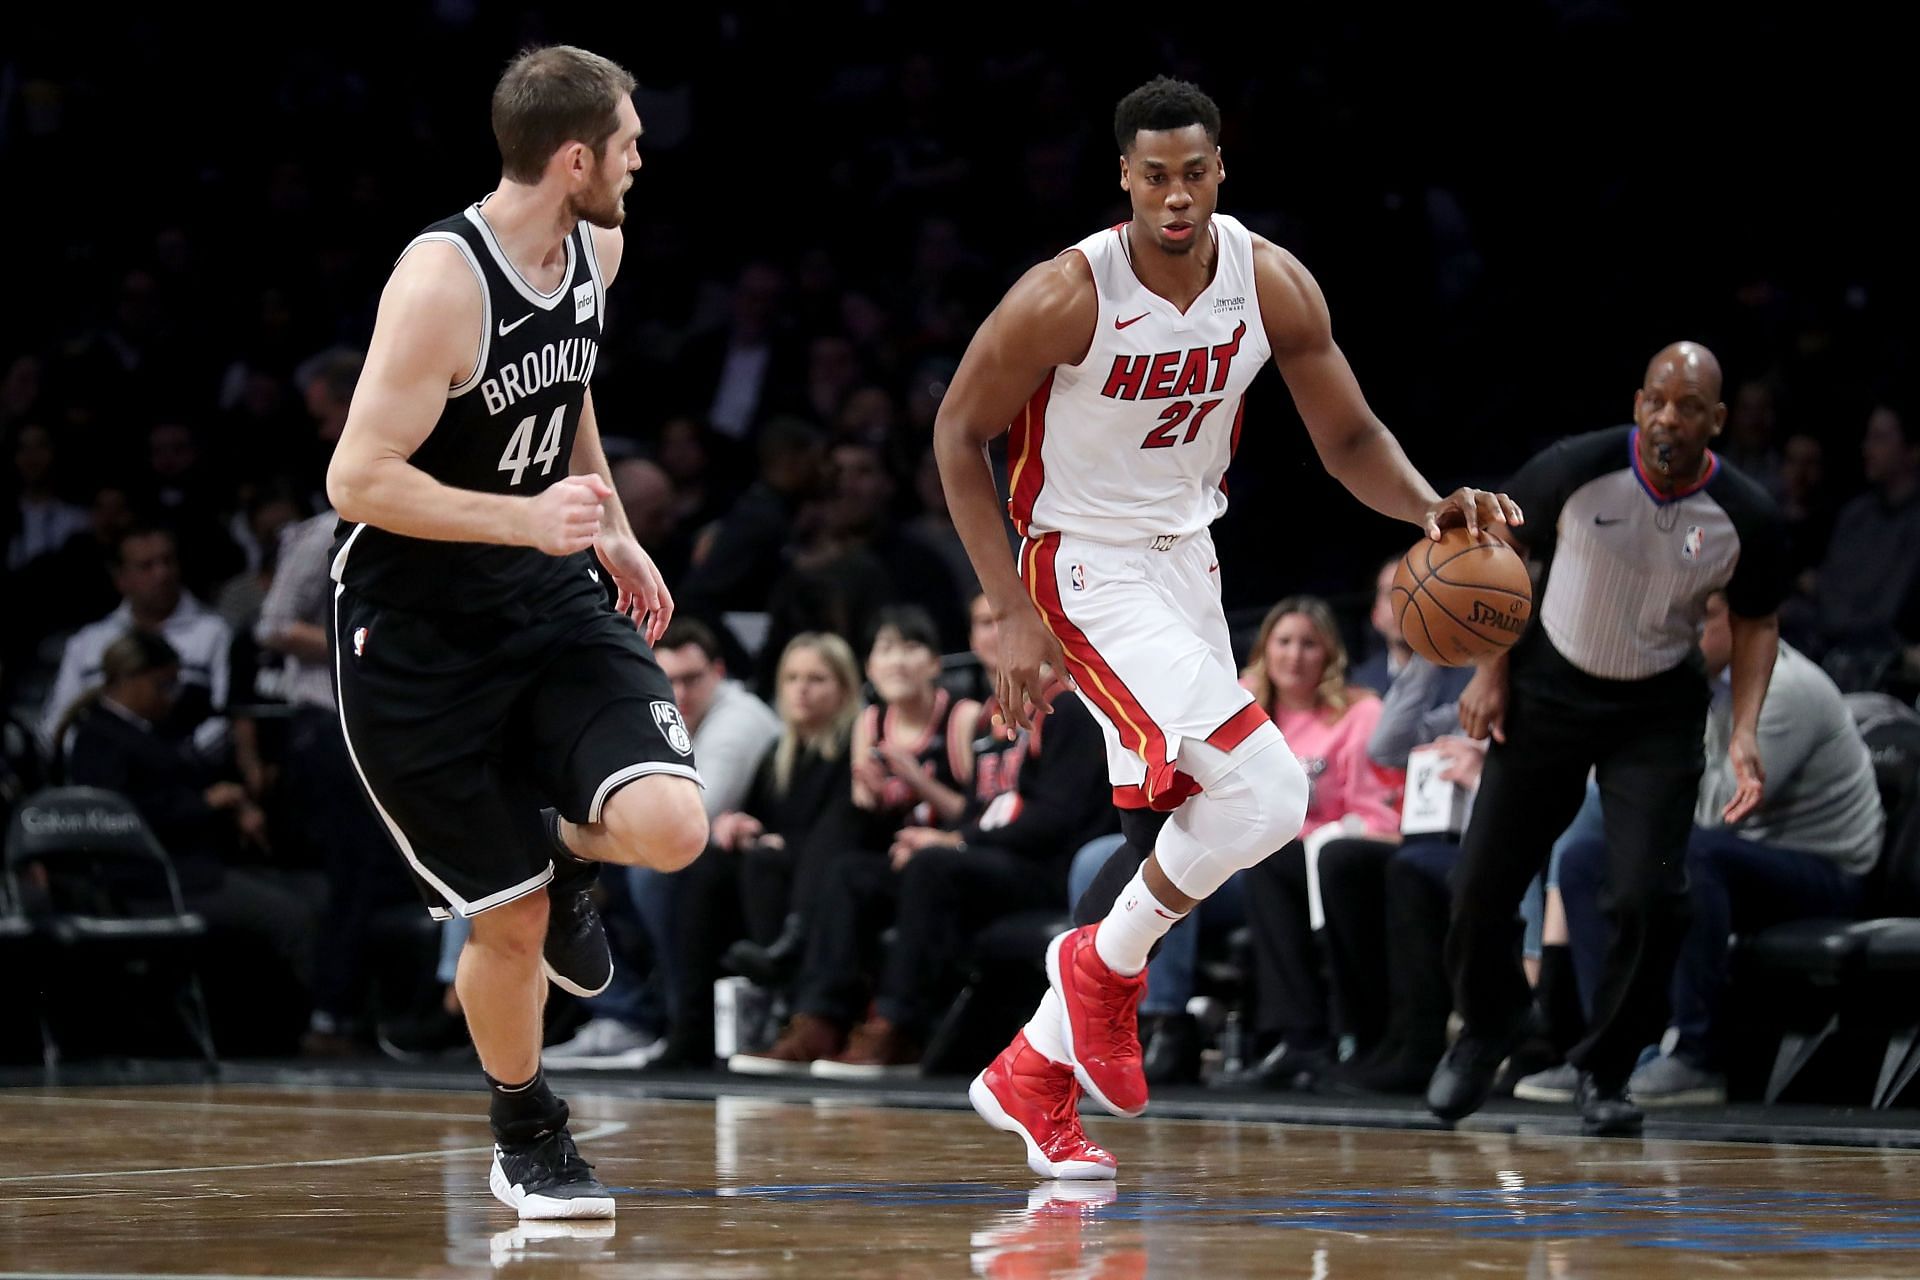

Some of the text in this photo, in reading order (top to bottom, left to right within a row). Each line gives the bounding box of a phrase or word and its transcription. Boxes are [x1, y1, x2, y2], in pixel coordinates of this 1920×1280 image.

[577, 294, 593, 310] infor
[1213, 296, 1246, 308] Ultimate
[1214, 305, 1244, 314] SOFTWARE
[480, 337, 599, 416] BROOKLYN
[1101, 319, 1246, 401] HEAT
[1140, 398, 1224, 449] 21
[497, 403, 567, 486] 44
[1467, 600, 1523, 633] SPALD
[654, 704, 683, 727] NET
